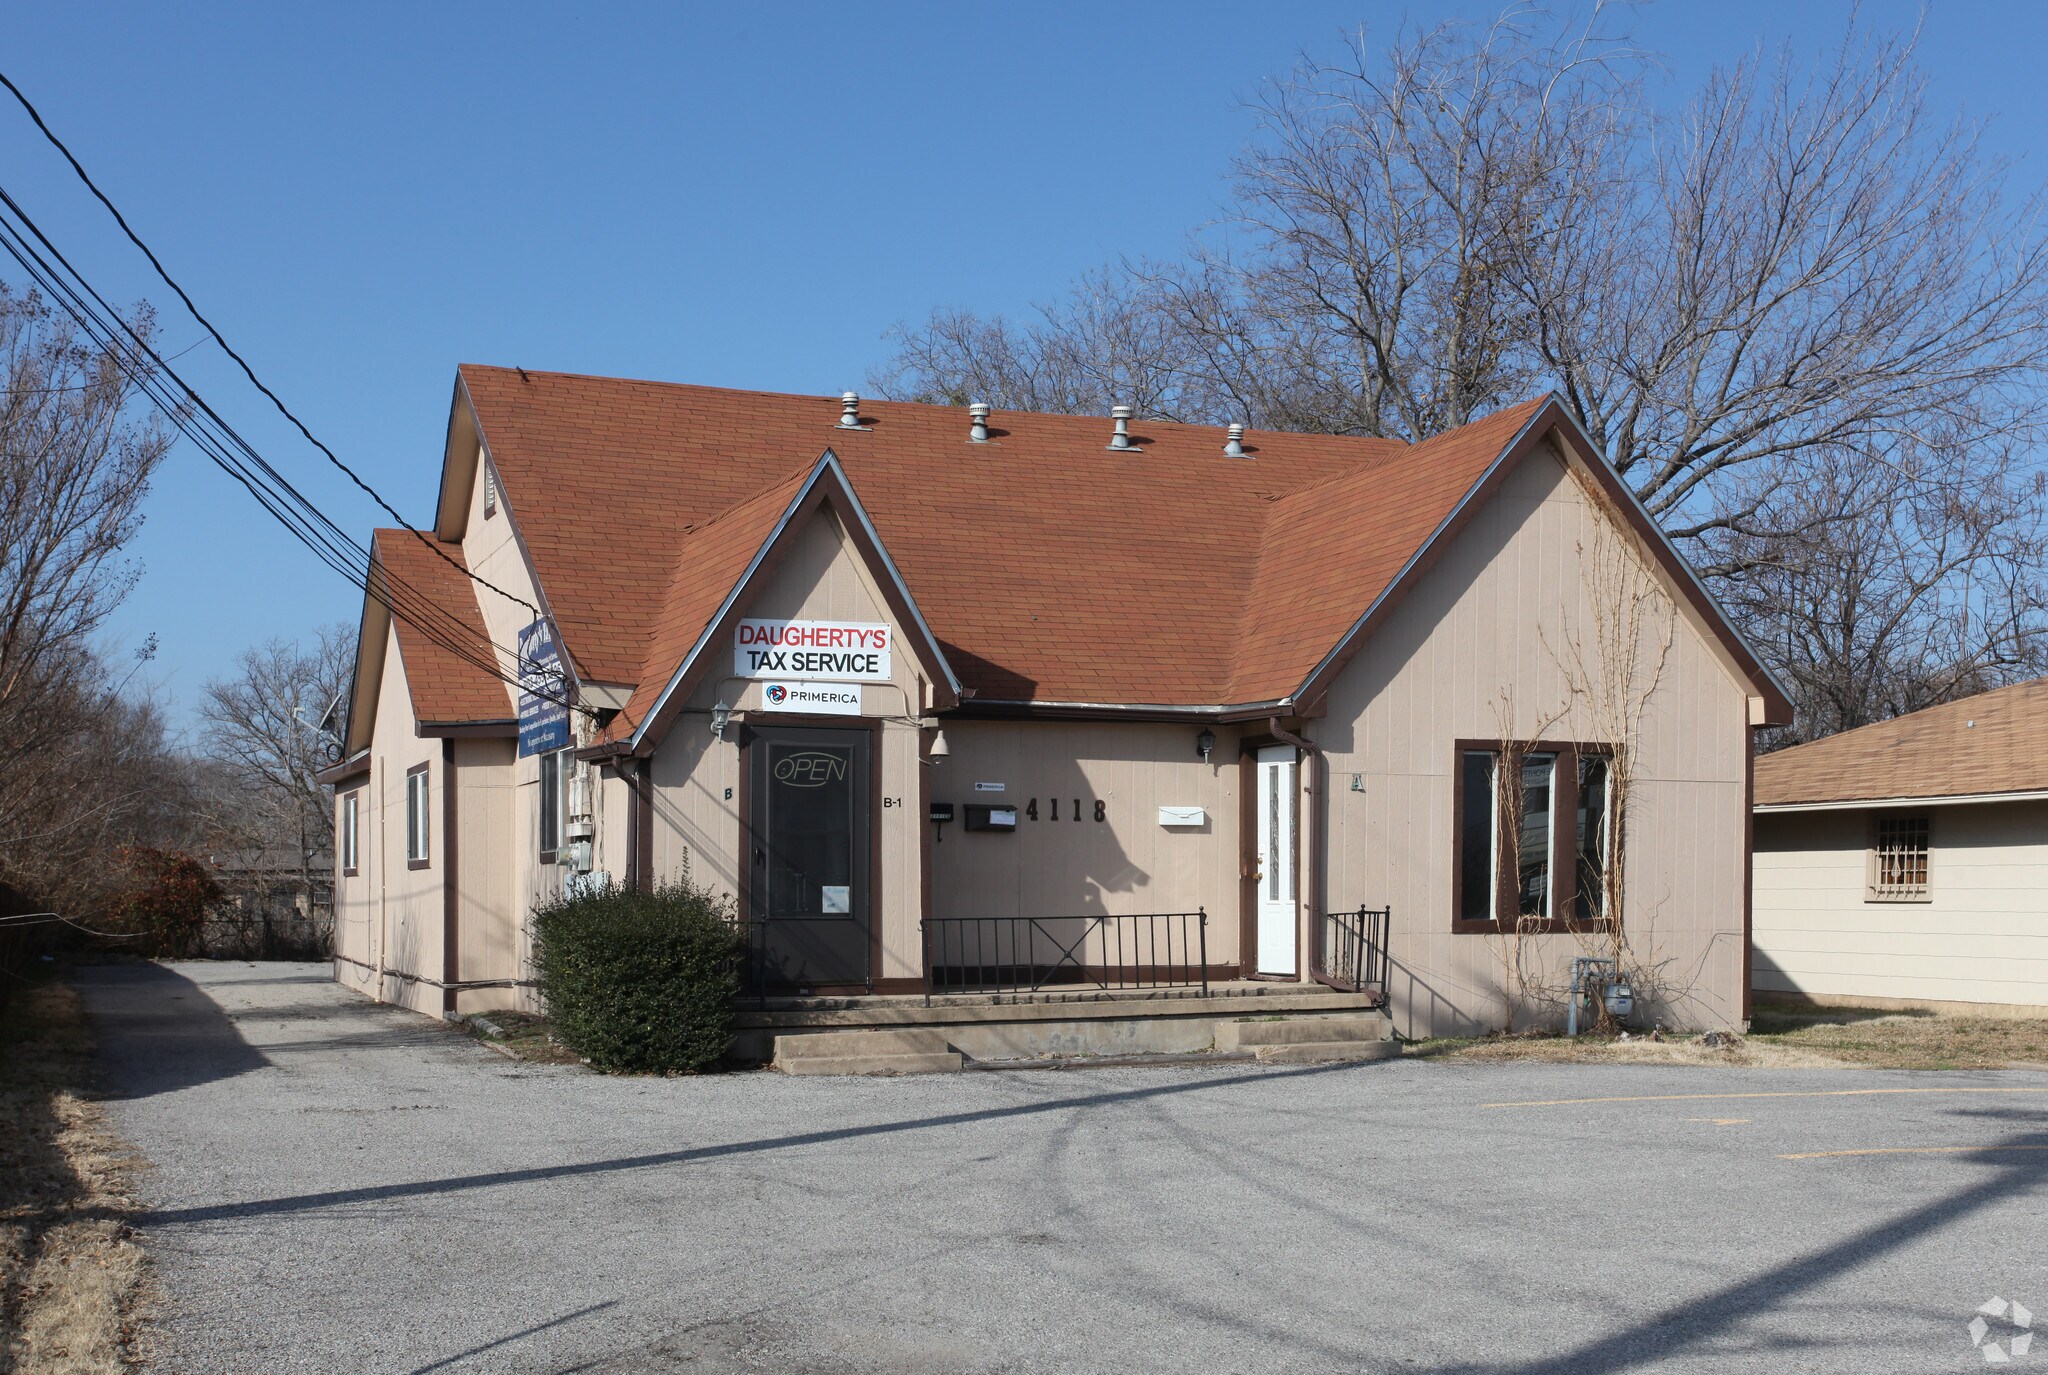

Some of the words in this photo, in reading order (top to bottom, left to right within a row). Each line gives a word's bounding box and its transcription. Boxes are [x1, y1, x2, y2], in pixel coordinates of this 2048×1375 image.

[739, 625, 886, 649] DAUGHERTY'S
[747, 650, 787, 671] TAX
[791, 651, 879, 673] SERVICE
[790, 691, 858, 704] PRIMERICA
[775, 758, 847, 781] OPEN
[1351, 774, 1364, 791] A
[724, 788, 732, 800] B
[883, 798, 902, 808] B-1
[1025, 798, 1106, 823] 4118
